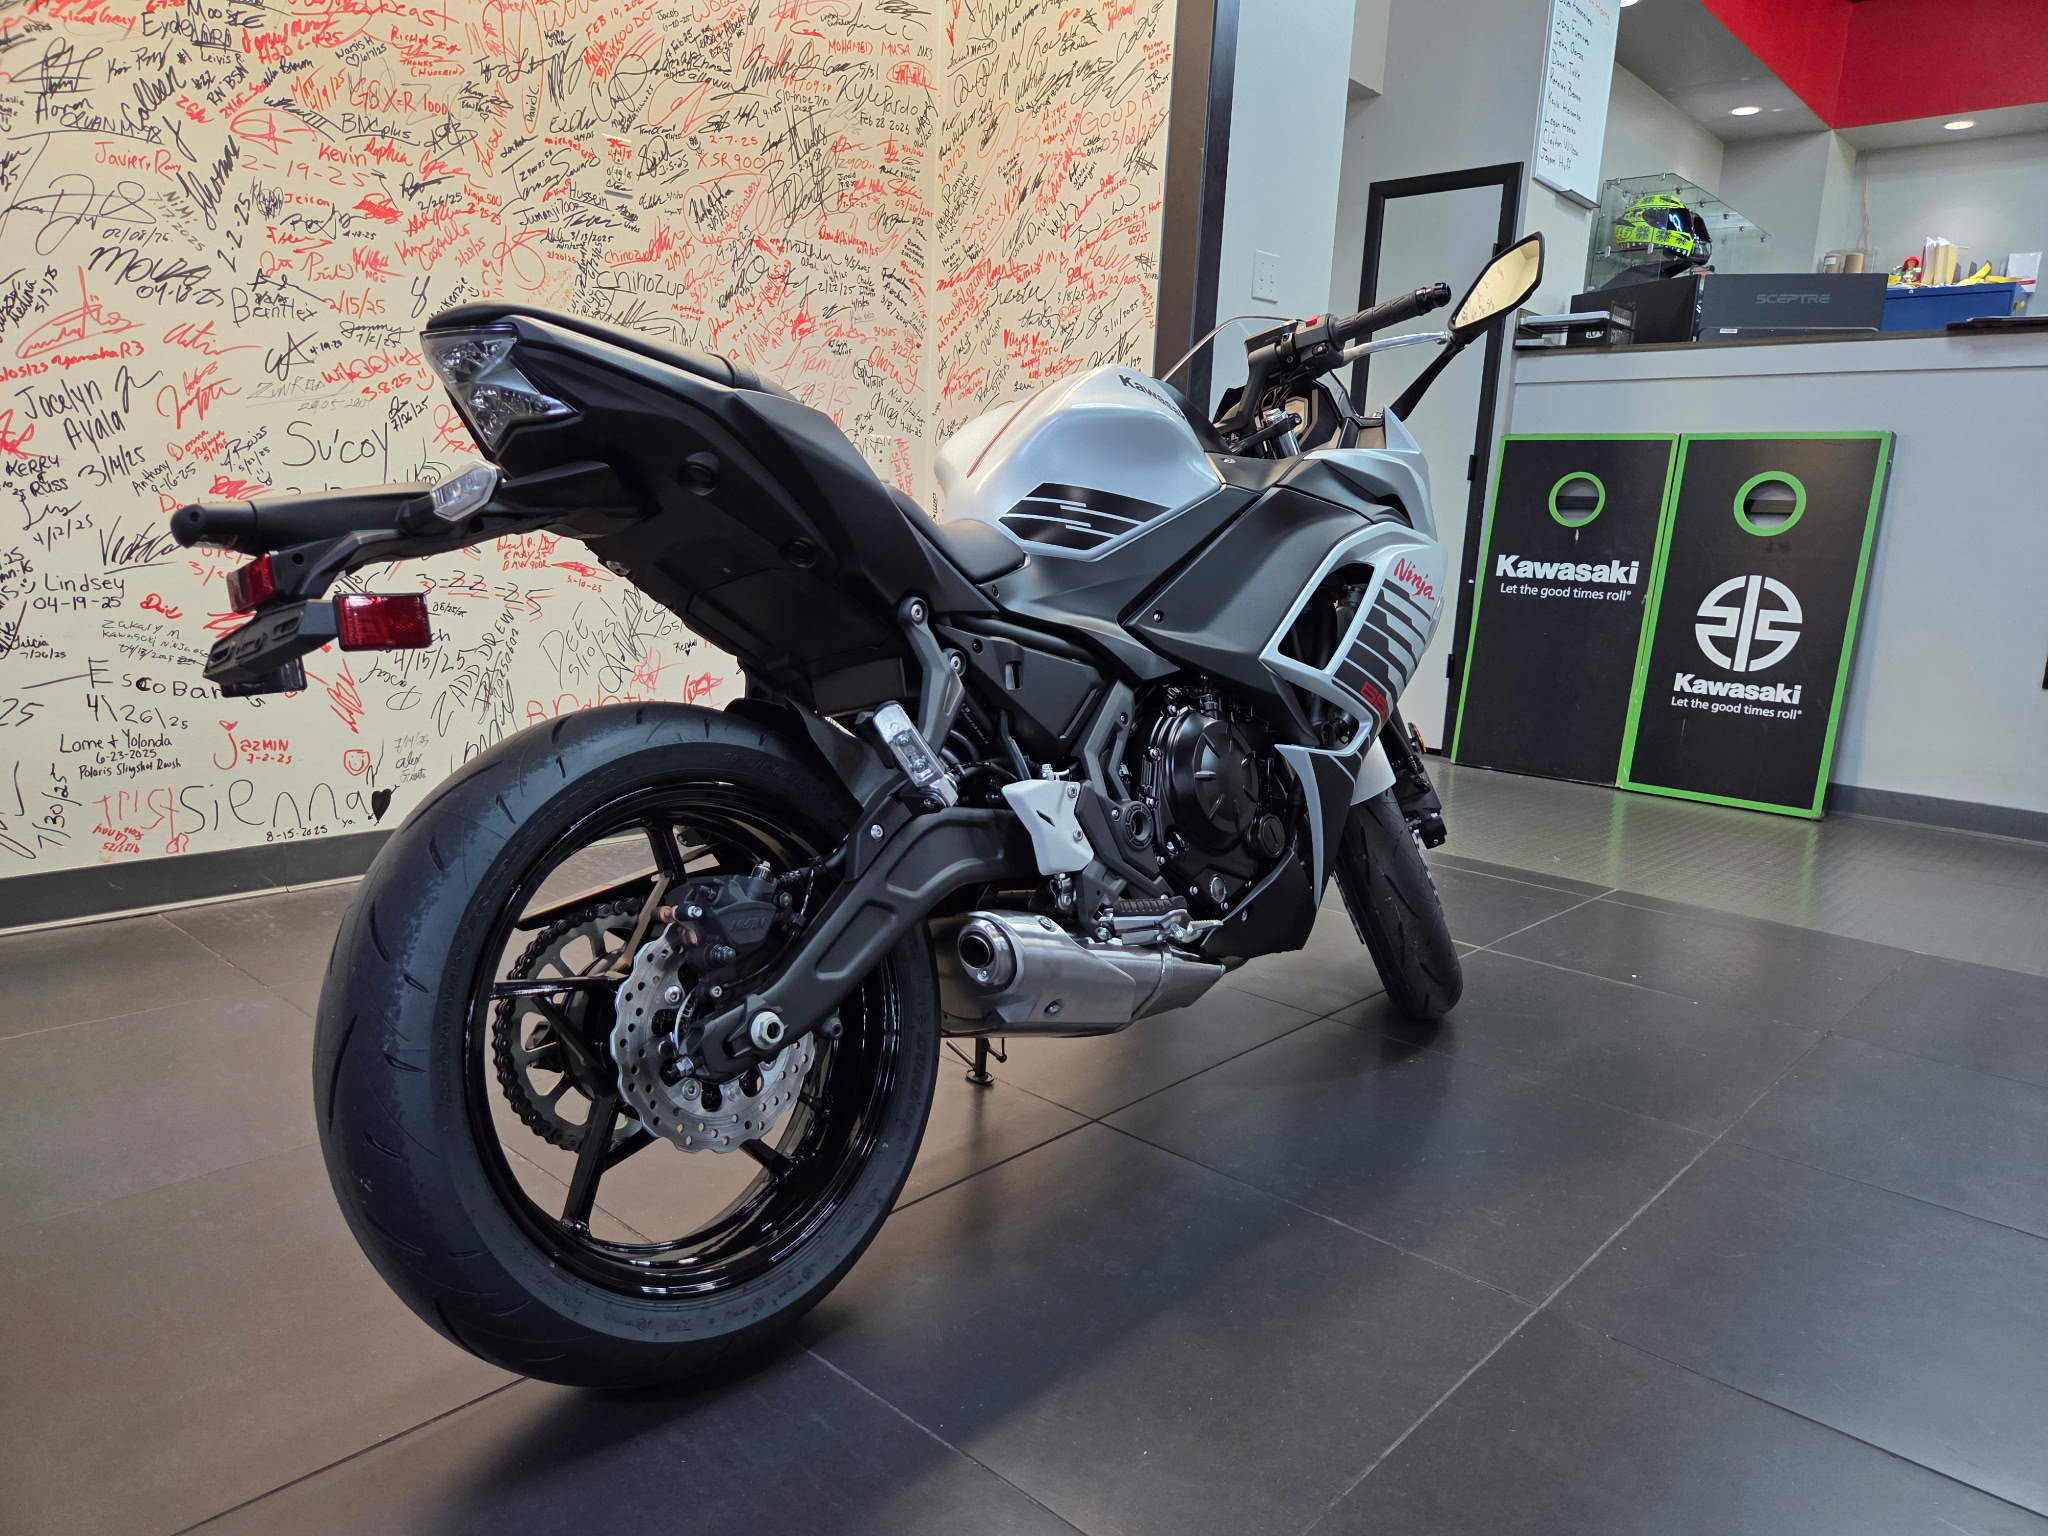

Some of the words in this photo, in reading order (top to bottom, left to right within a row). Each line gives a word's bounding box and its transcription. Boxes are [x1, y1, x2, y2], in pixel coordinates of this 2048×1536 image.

[1080, 90, 1152, 136] GOUDA
[318, 142, 367, 167] Kevin
[241, 154, 370, 188] 2-19-25
[418, 192, 463, 214] 2/26/25
[568, 181, 610, 211] Hussein
[14, 379, 103, 420] Jocelyn
[78, 444, 147, 487] 3/14/25
[567, 575, 603, 593] 5-10-25
[1393, 557, 1435, 601] Ninja
[1495, 554, 1640, 585] Kawasaki
[44, 572, 126, 600] Lindsey
[1500, 583, 1518, 594] Let
[1519, 584, 1538, 595] the
[1540, 586, 1570, 598] good
[1573, 587, 1604, 600] times
[32, 595, 122, 614] 04-19-25
[1673, 672, 1802, 705] Kawasaki
[1671, 696, 1688, 708] Let
[1690, 697, 1709, 710] the
[1711, 700, 1741, 714] good
[1744, 704, 1775, 718] times
[95, 749, 158, 765] 6-23-2025
